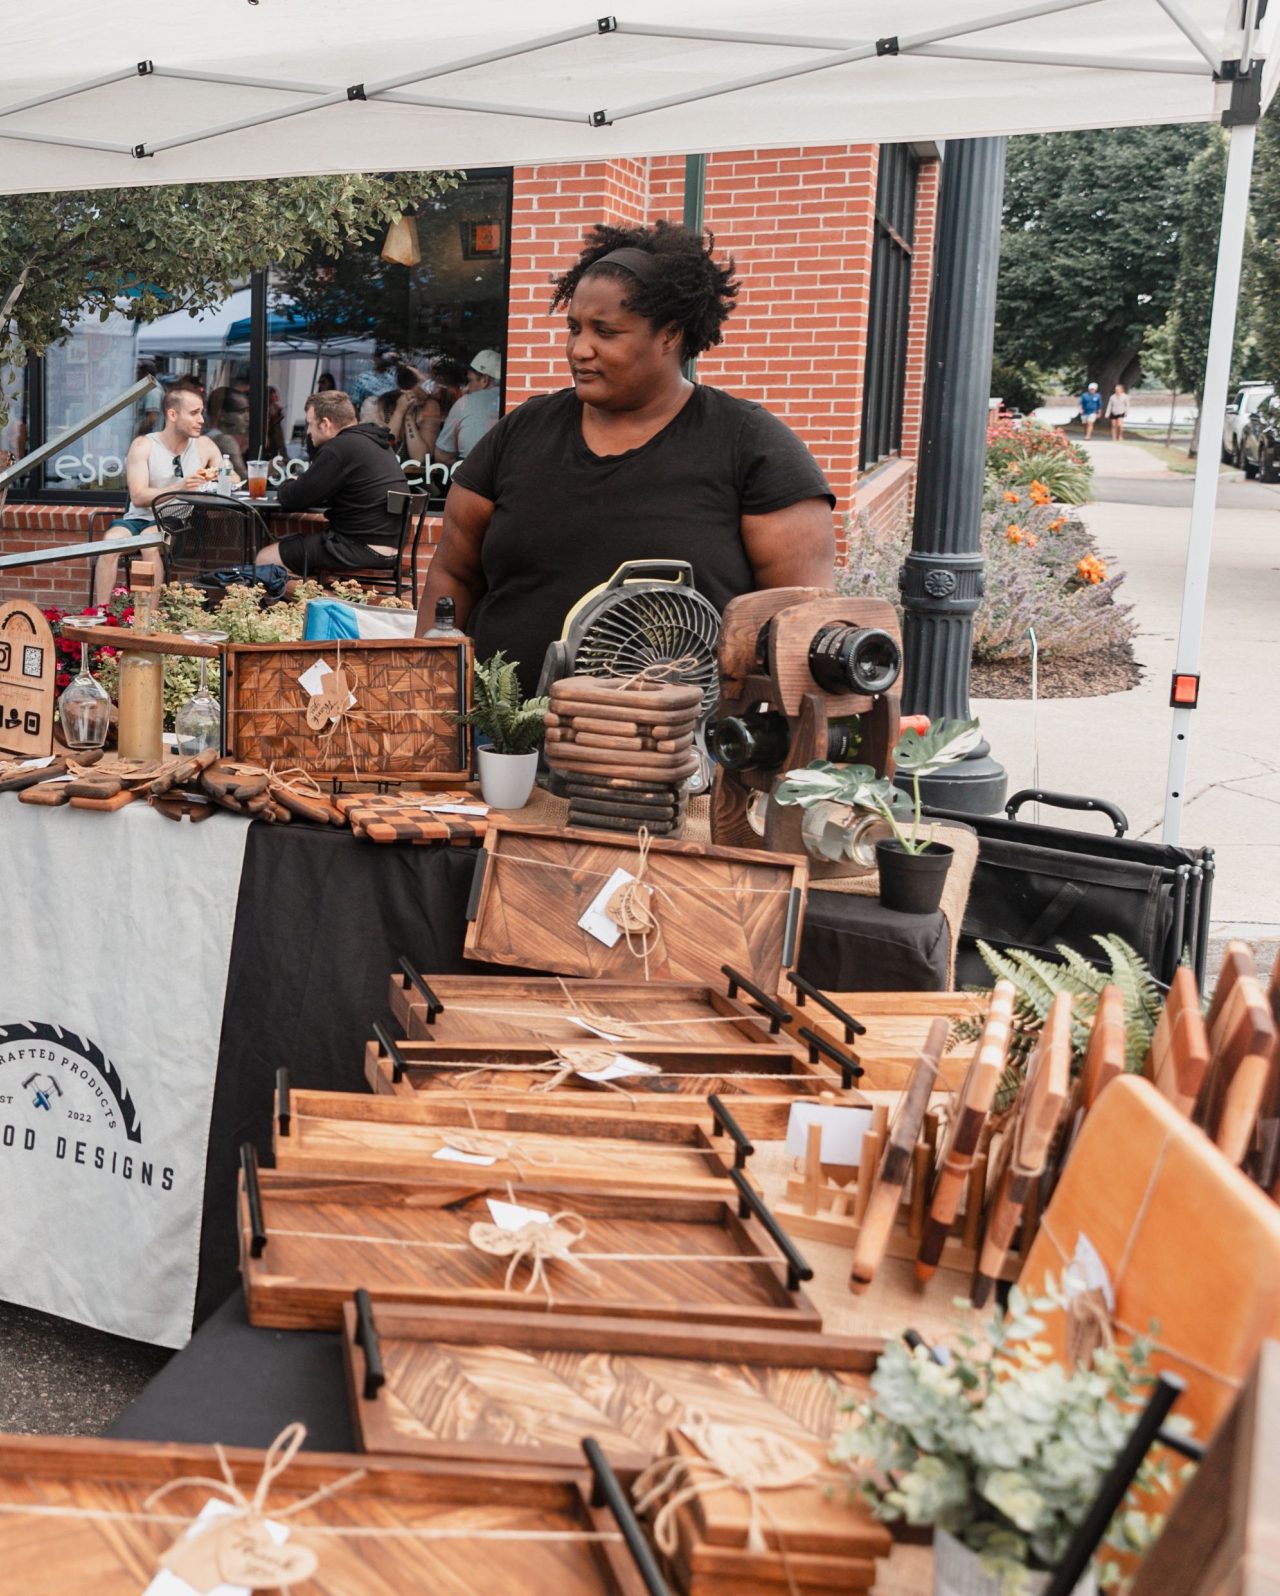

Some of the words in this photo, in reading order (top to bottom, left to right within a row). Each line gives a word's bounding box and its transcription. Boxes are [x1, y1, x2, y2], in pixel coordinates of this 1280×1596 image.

[54, 453, 127, 486] esp
[60, 1057, 117, 1129] PRODUCTS
[67, 1110, 92, 1123] 2022
[56, 1136, 174, 1191] DESIGNS
